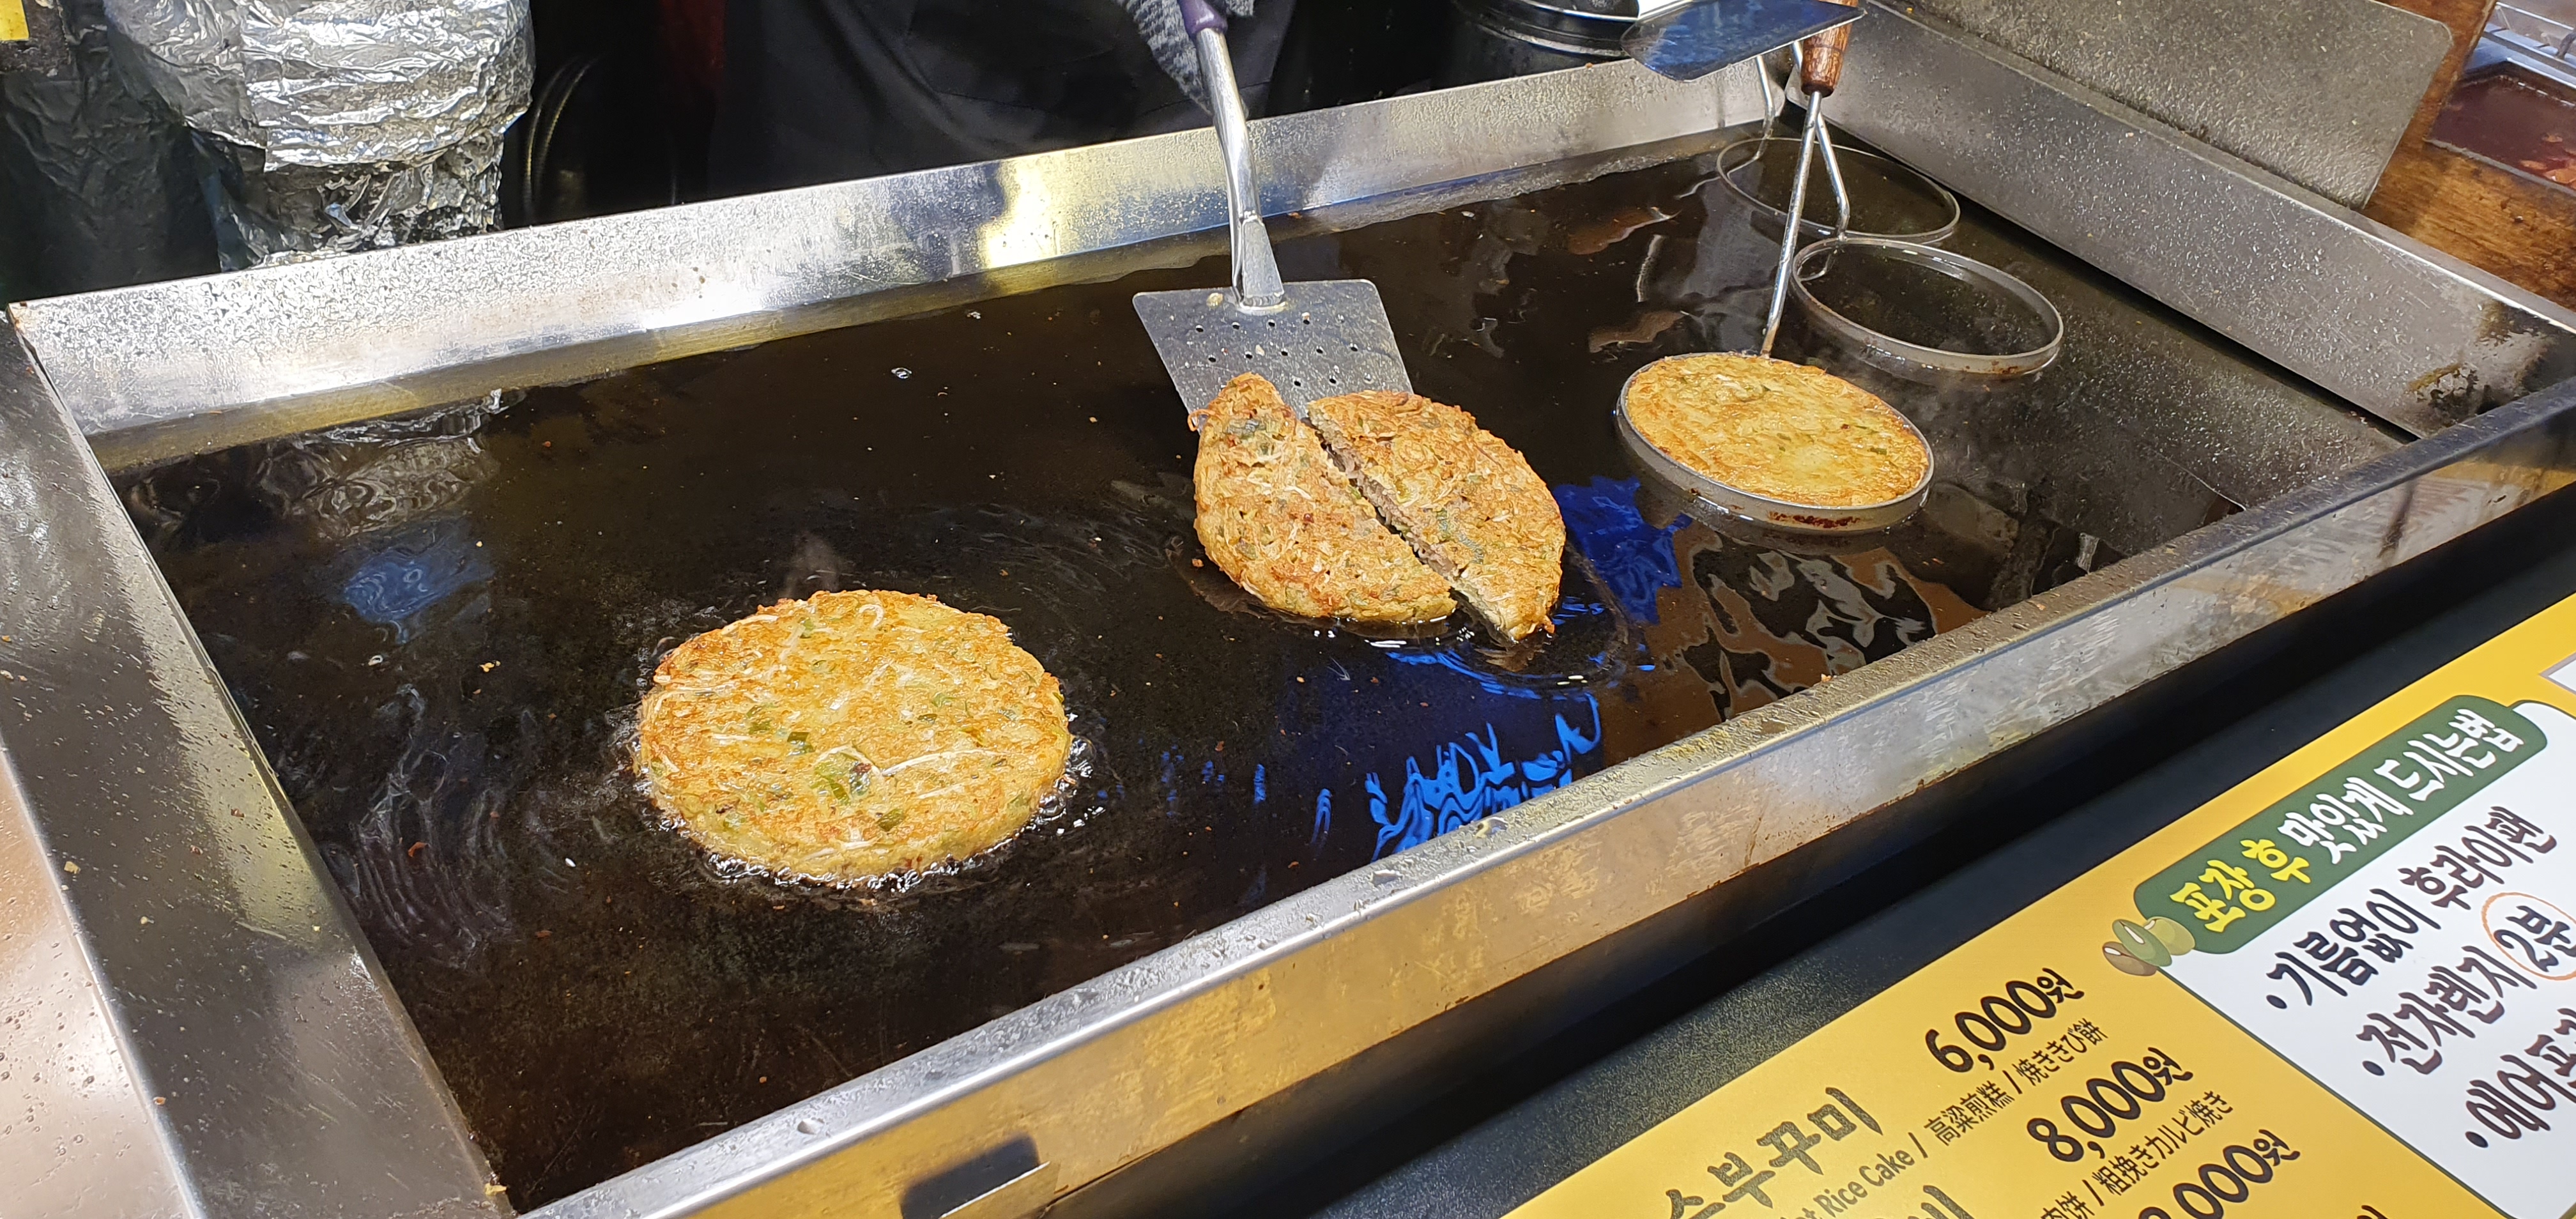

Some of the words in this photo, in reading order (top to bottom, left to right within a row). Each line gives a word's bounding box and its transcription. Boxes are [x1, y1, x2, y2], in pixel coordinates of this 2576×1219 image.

[2170, 859, 2276, 933] 포장
[2240, 839, 2311, 884] 후
[2277, 777, 2414, 864] 맛있게
[2373, 709, 2524, 801] 드시는법
[2266, 889, 2441, 1006] 기름없이
[2398, 806, 2557, 910] 후라이팬
[1925, 967, 2085, 1073] 6,000원
[2027, 1046, 2193, 1162] 8,000원
[2092, 1091, 2233, 1195] 粗挽きカルビ焼き
[1813, 1181, 1867, 1218] Rice
[1859, 1150, 1915, 1186] Cake
